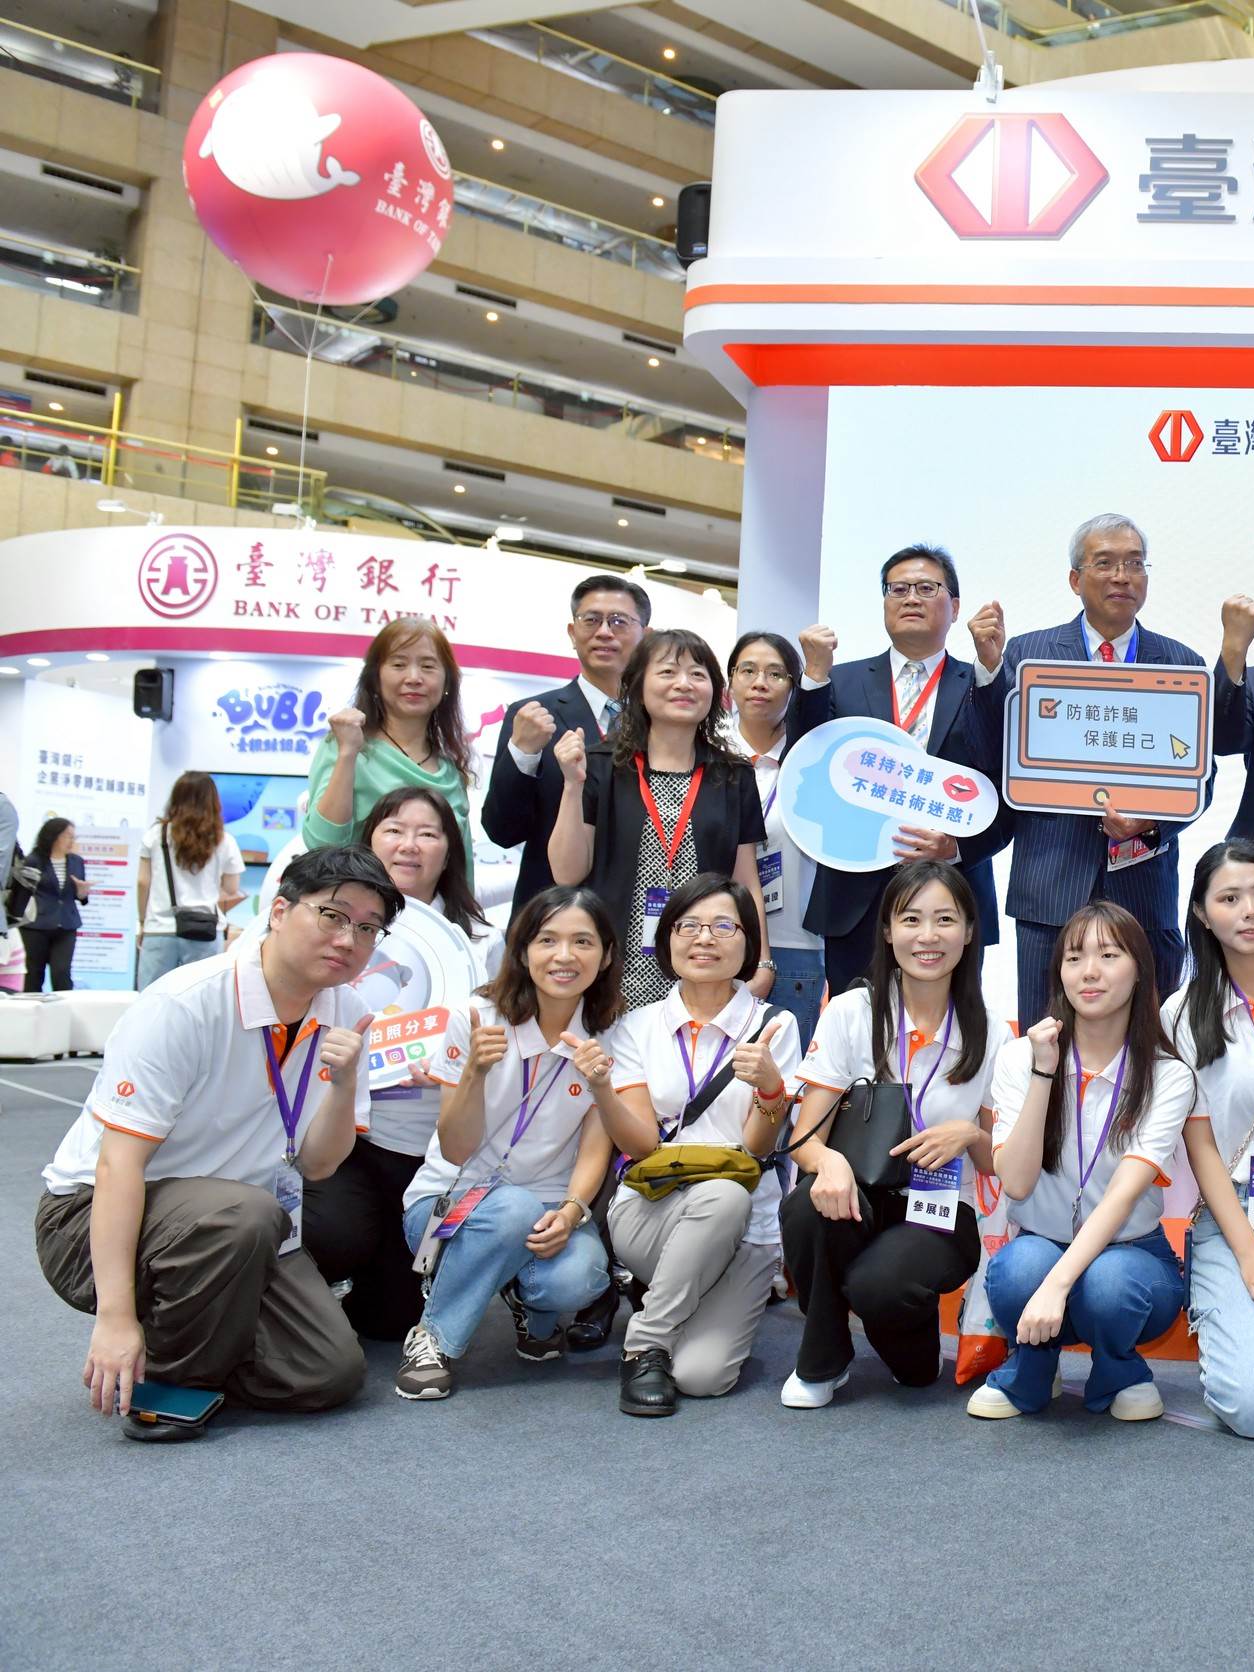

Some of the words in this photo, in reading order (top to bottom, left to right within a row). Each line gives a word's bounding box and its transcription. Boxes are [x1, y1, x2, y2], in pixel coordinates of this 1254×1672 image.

[375, 199, 413, 227] BANK
[413, 219, 429, 236] OF
[236, 541, 462, 604] 臺灣銀行
[233, 600, 301, 619] BANK
[314, 604, 348, 621] OF
[1066, 703, 1139, 724] 防範詐騙
[1083, 729, 1156, 751] 保護自己
[860, 750, 935, 786] 保持冷靜
[369, 1014, 439, 1046] 拍照分享
[912, 1200, 951, 1218] 參展證
